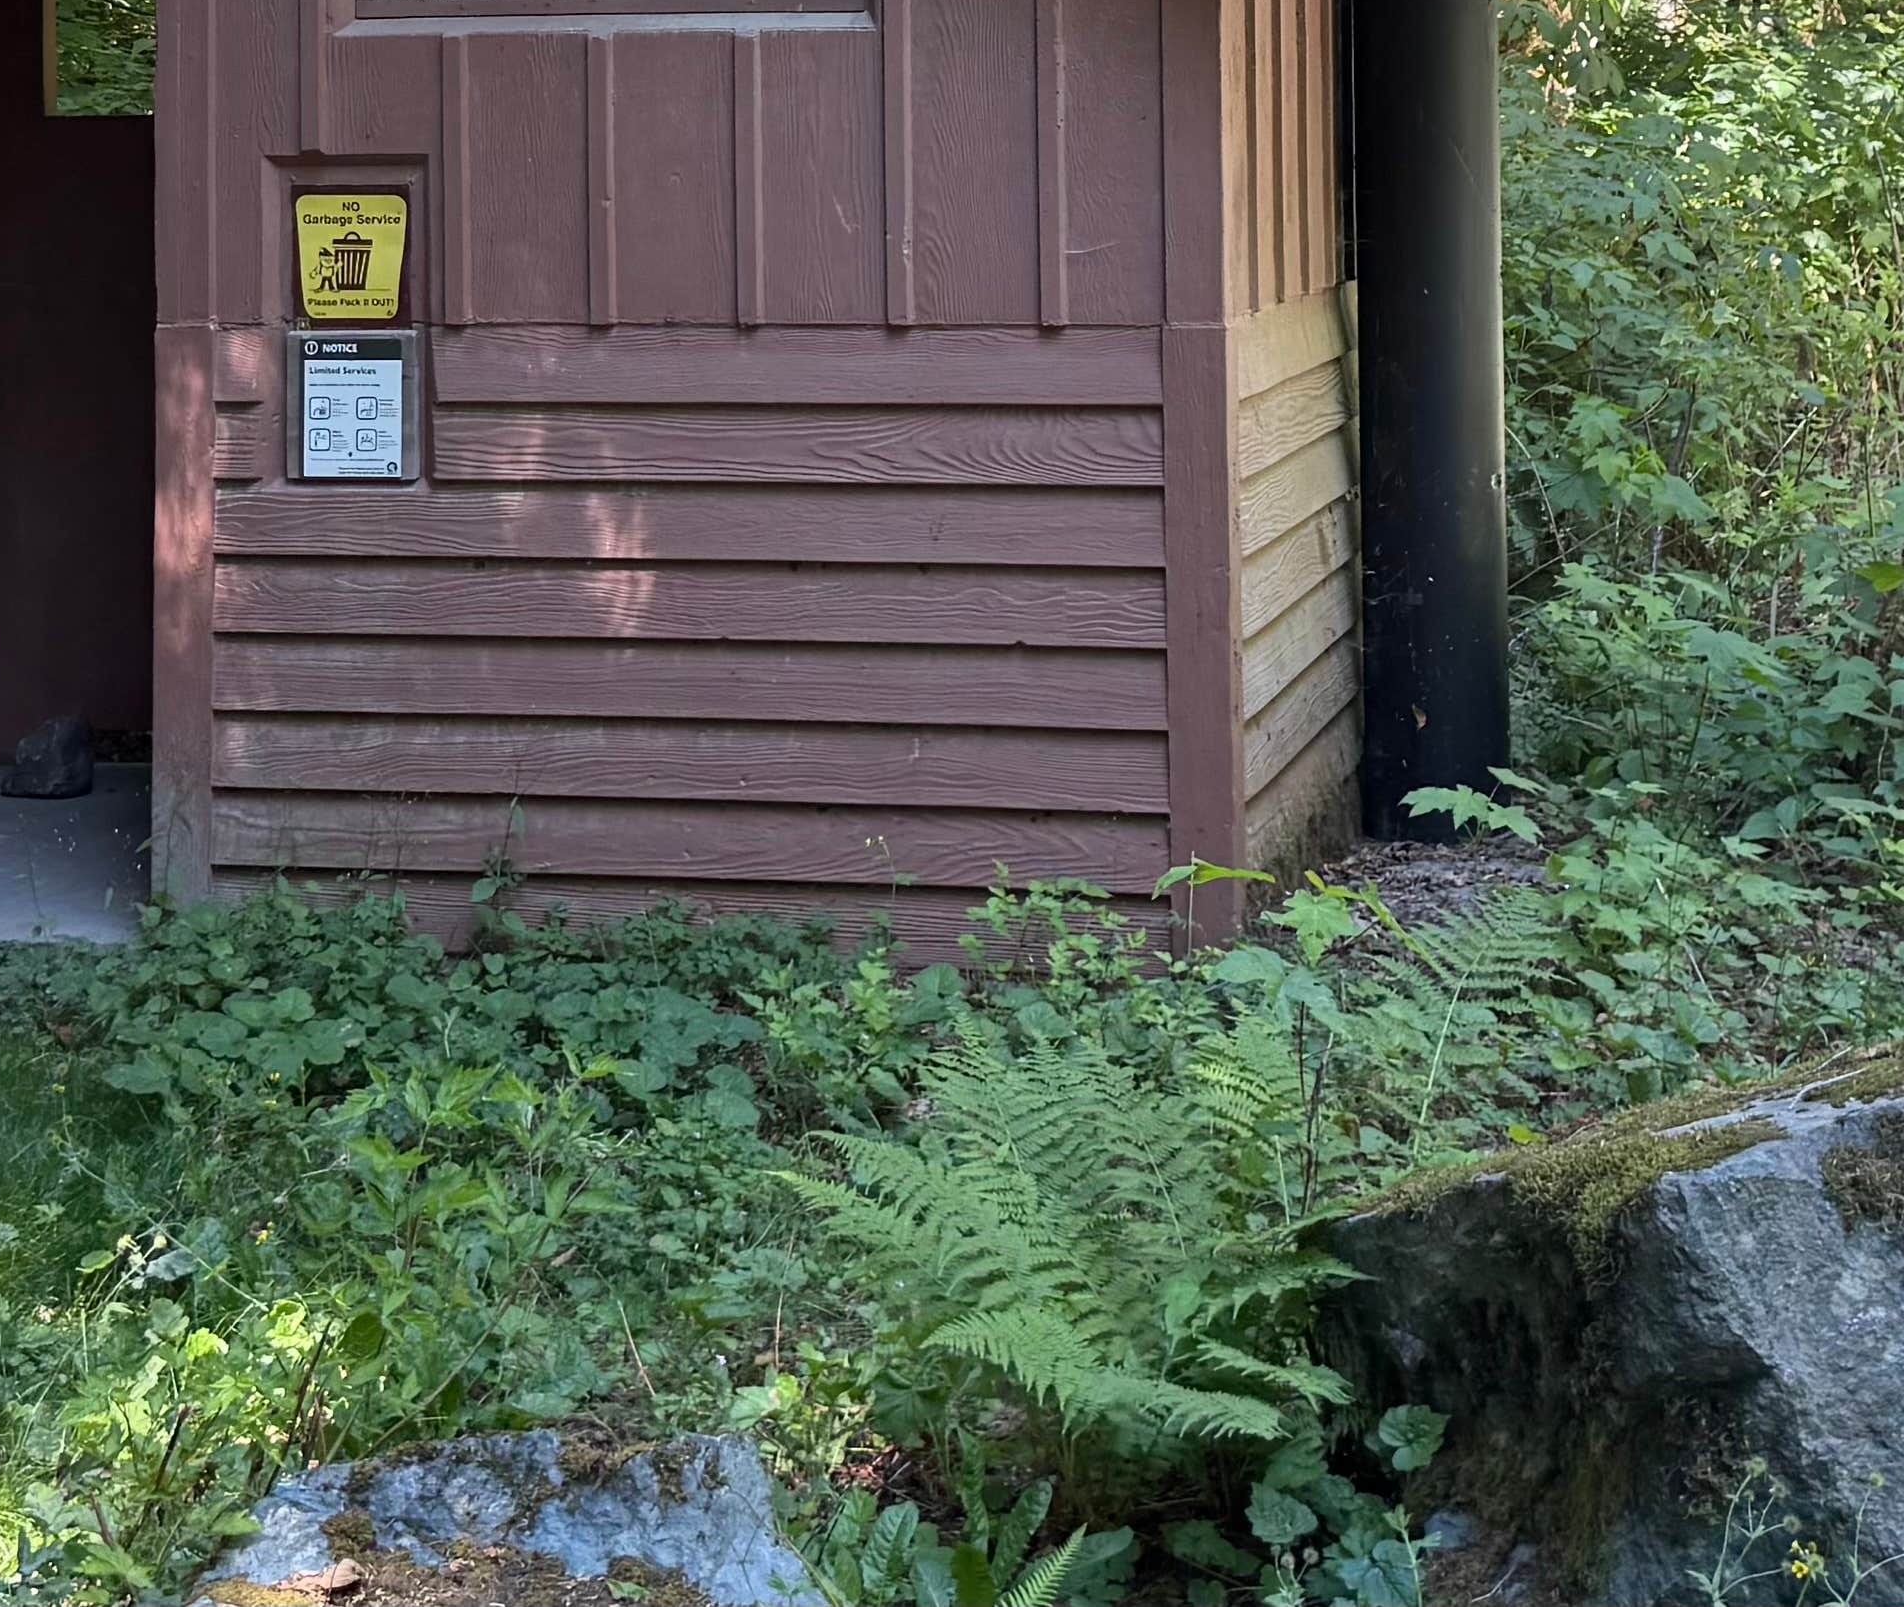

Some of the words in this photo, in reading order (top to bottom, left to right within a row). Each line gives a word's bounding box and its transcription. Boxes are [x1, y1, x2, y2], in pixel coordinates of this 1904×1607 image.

[342, 202, 360, 212] NO
[303, 214, 353, 226] Garbage
[356, 214, 401, 224] Service
[322, 344, 358, 353] NOTICE
[309, 366, 340, 375] Limited
[343, 366, 376, 375] Services
